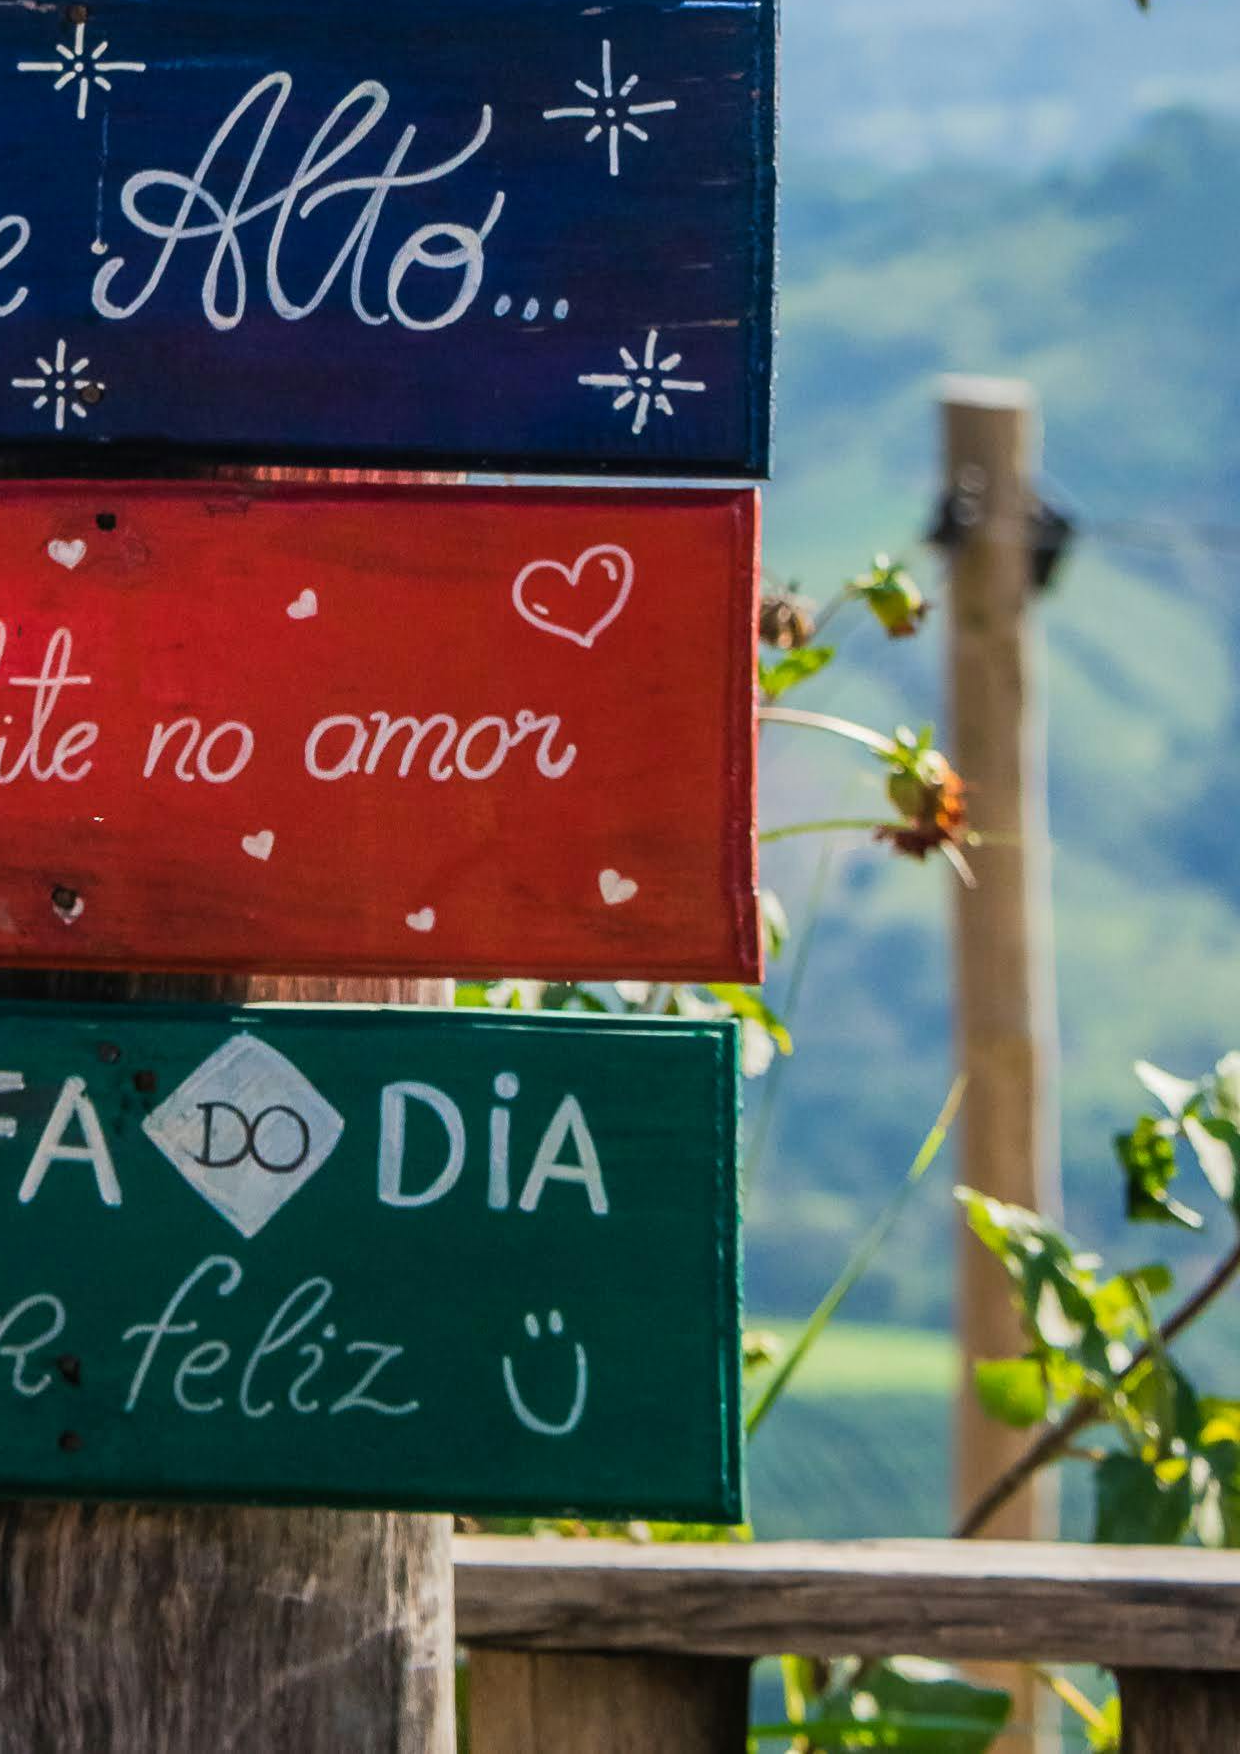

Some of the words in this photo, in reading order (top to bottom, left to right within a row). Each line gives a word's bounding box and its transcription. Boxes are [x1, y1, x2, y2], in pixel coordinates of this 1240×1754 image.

[142, 718, 255, 784] no
[303, 706, 577, 782] amor
[193, 1099, 312, 1175] DO
[121, 1254, 420, 1418] feliz
